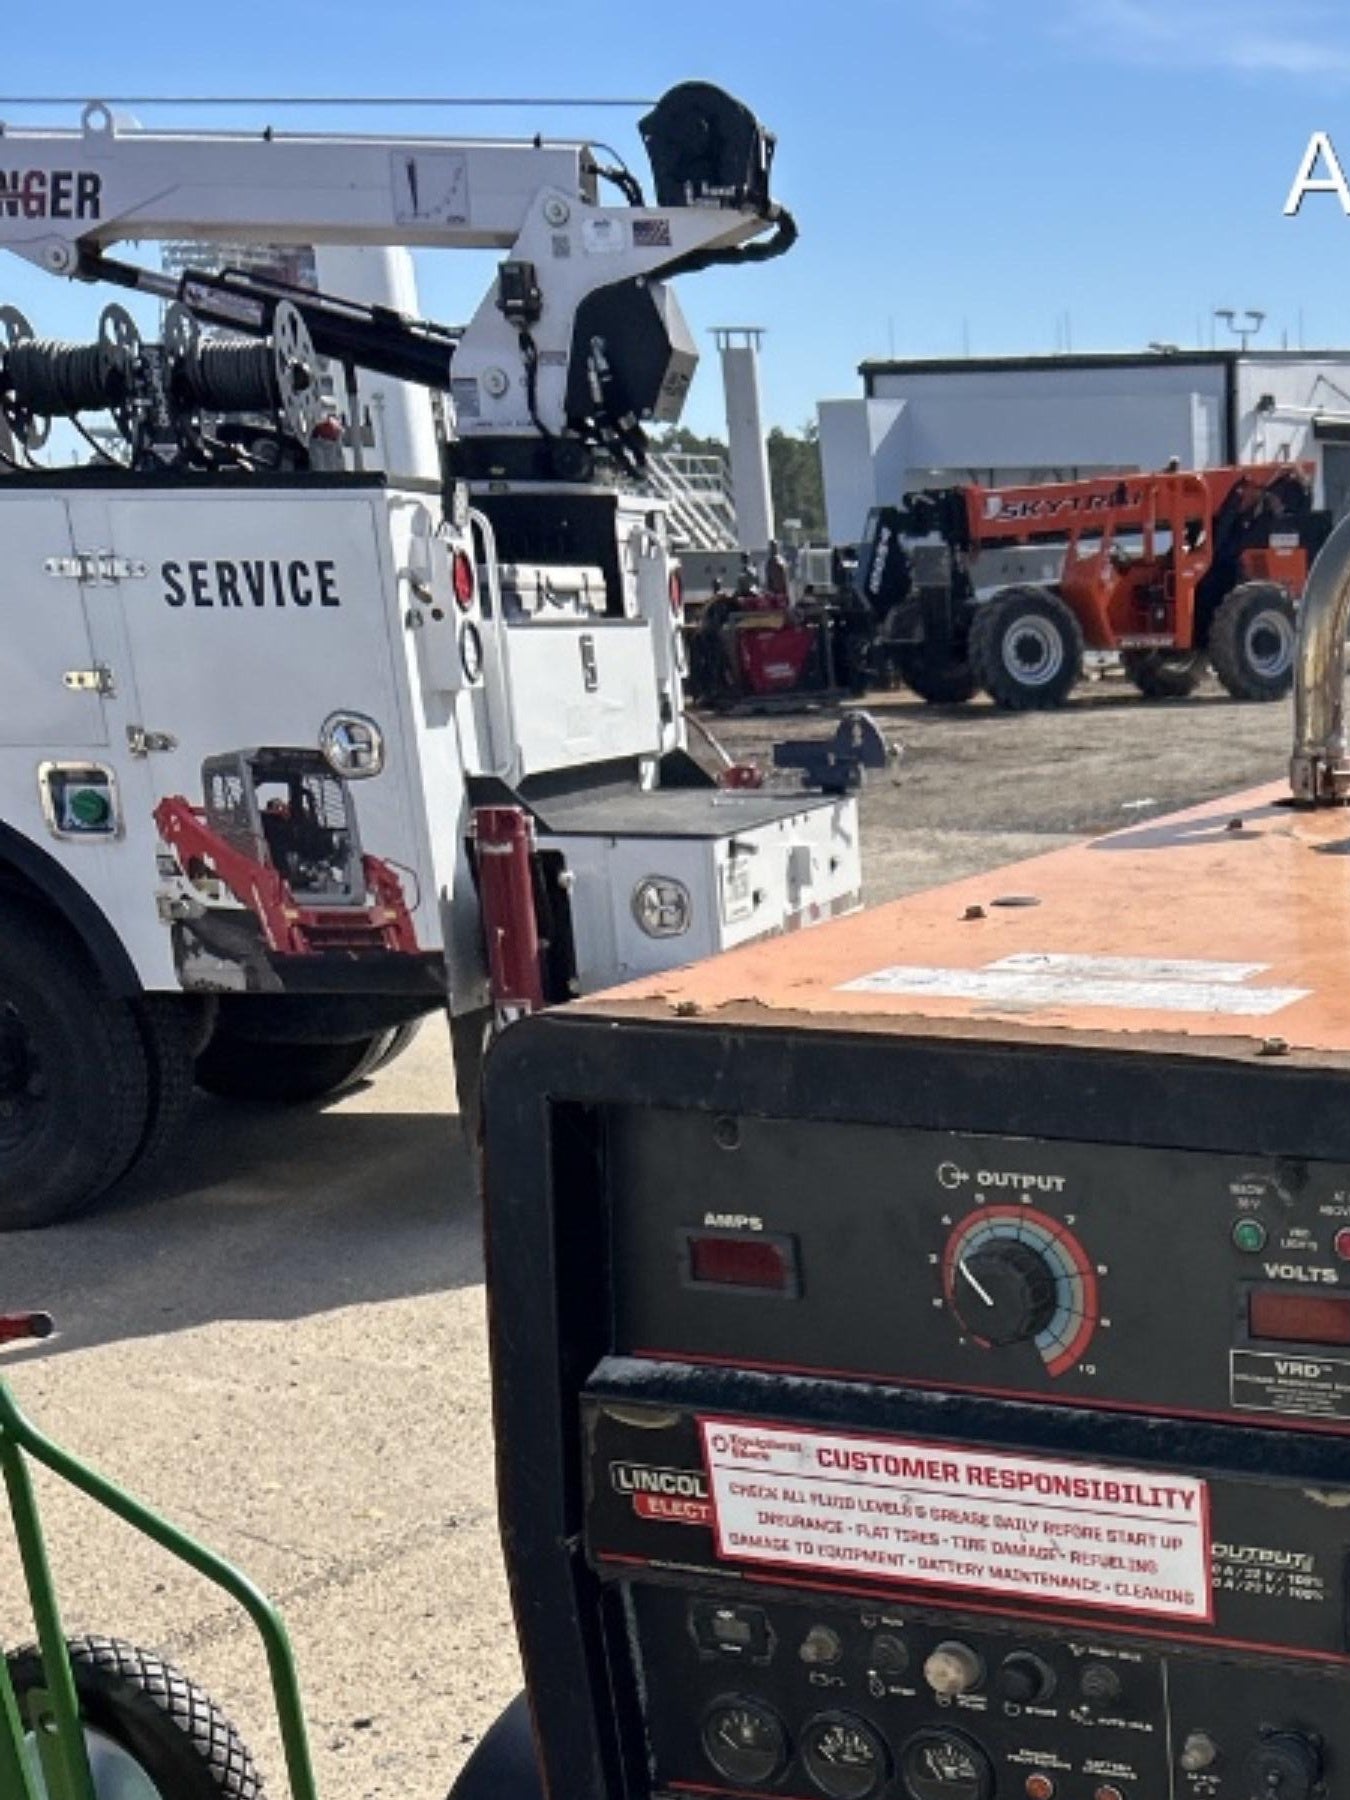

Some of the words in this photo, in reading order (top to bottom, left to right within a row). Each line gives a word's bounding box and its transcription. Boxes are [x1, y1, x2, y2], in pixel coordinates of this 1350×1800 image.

[161, 560, 341, 607] SERVICE
[976, 1171, 1067, 1192] OUTPUT
[704, 1212, 763, 1231] AMPS
[1263, 1262, 1339, 1283] VOLTS
[817, 1447, 960, 1483] CUSTOMER
[966, 1465, 1195, 1511] RESPONSIBILITY
[728, 1482, 778, 1500] CHECK
[782, 1489, 806, 1504] ALL
[810, 1492, 855, 1510] FLUID
[858, 1499, 912, 1518] LEVELS
[930, 1507, 991, 1528] GREASE
[993, 1513, 1038, 1532] DAILY
[1042, 1519, 1103, 1543] BEFORE
[1106, 1529, 1156, 1549] START
[1160, 1535, 1183, 1550] UP
[757, 1510, 845, 1534] INSURANCE
[855, 1523, 890, 1540] FLAT
[894, 1528, 940, 1546] TIRES
[950, 1535, 988, 1553] TIRE
[991, 1540, 1057, 1562] DAMAGE
[1070, 1550, 1159, 1575] REFUELING
[728, 1531, 790, 1552] DAMAGE
[794, 1541, 813, 1556] TO
[816, 1543, 907, 1568] EQUIPMENT
[917, 1556, 985, 1578] BATTERY
[988, 1564, 1102, 1594] MAINTENANCE
[1114, 1581, 1195, 1606] CLEANING
